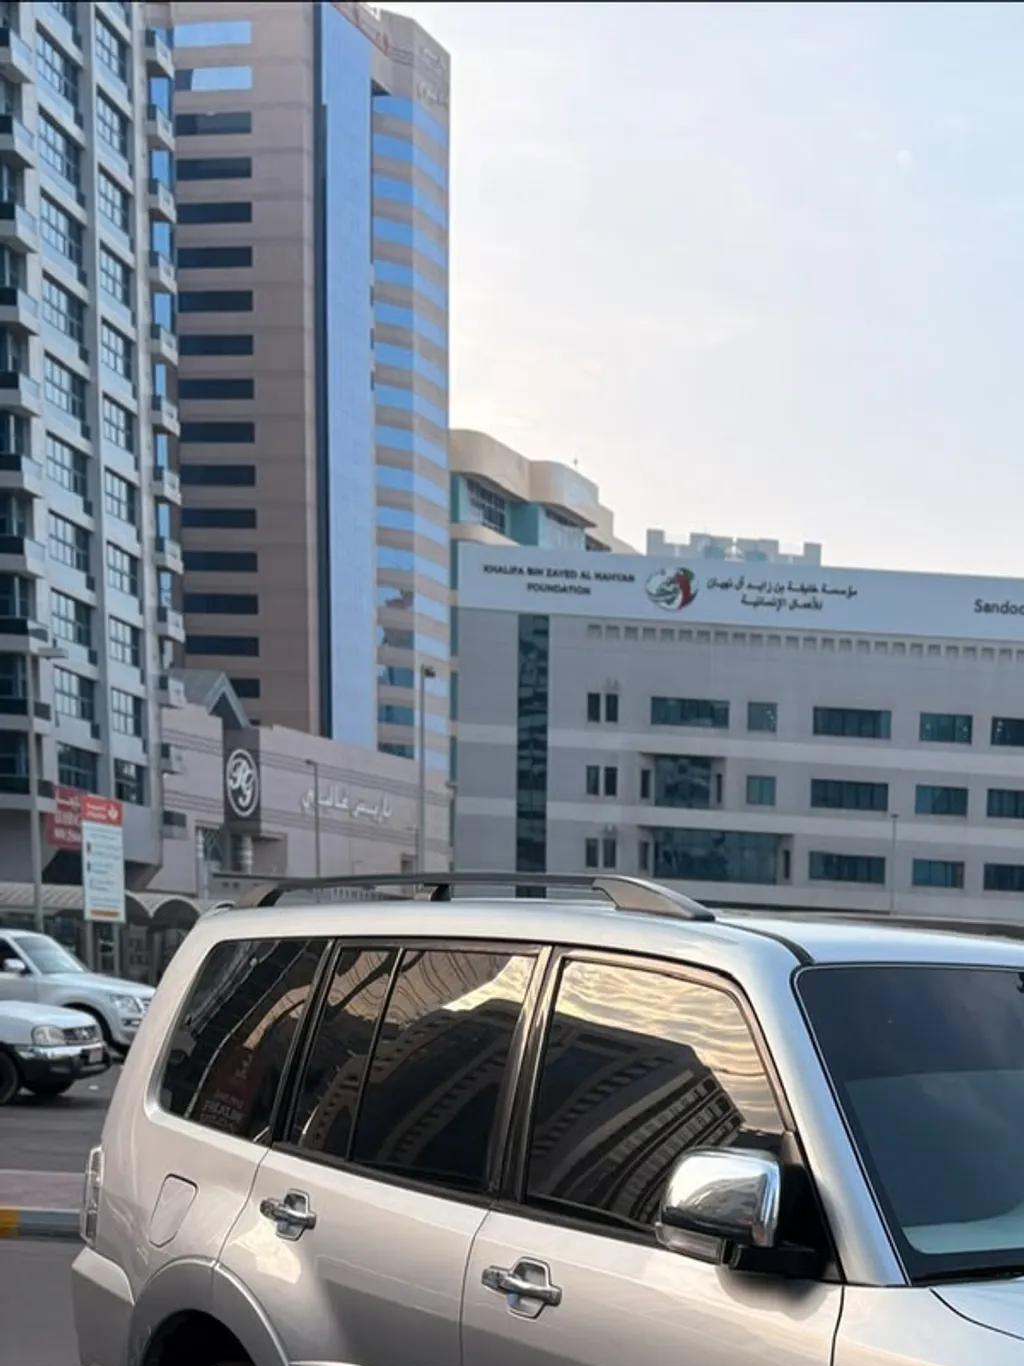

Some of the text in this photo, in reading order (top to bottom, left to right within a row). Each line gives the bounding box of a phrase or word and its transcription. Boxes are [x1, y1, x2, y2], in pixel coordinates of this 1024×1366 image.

[483, 563, 635, 583] KHALIFA BIN ZAYED AL NAHYAN
[526, 581, 592, 596] FOUNDATION
[821, 581, 858, 599] مؤسسة
[301, 783, 349, 812] غاليي
